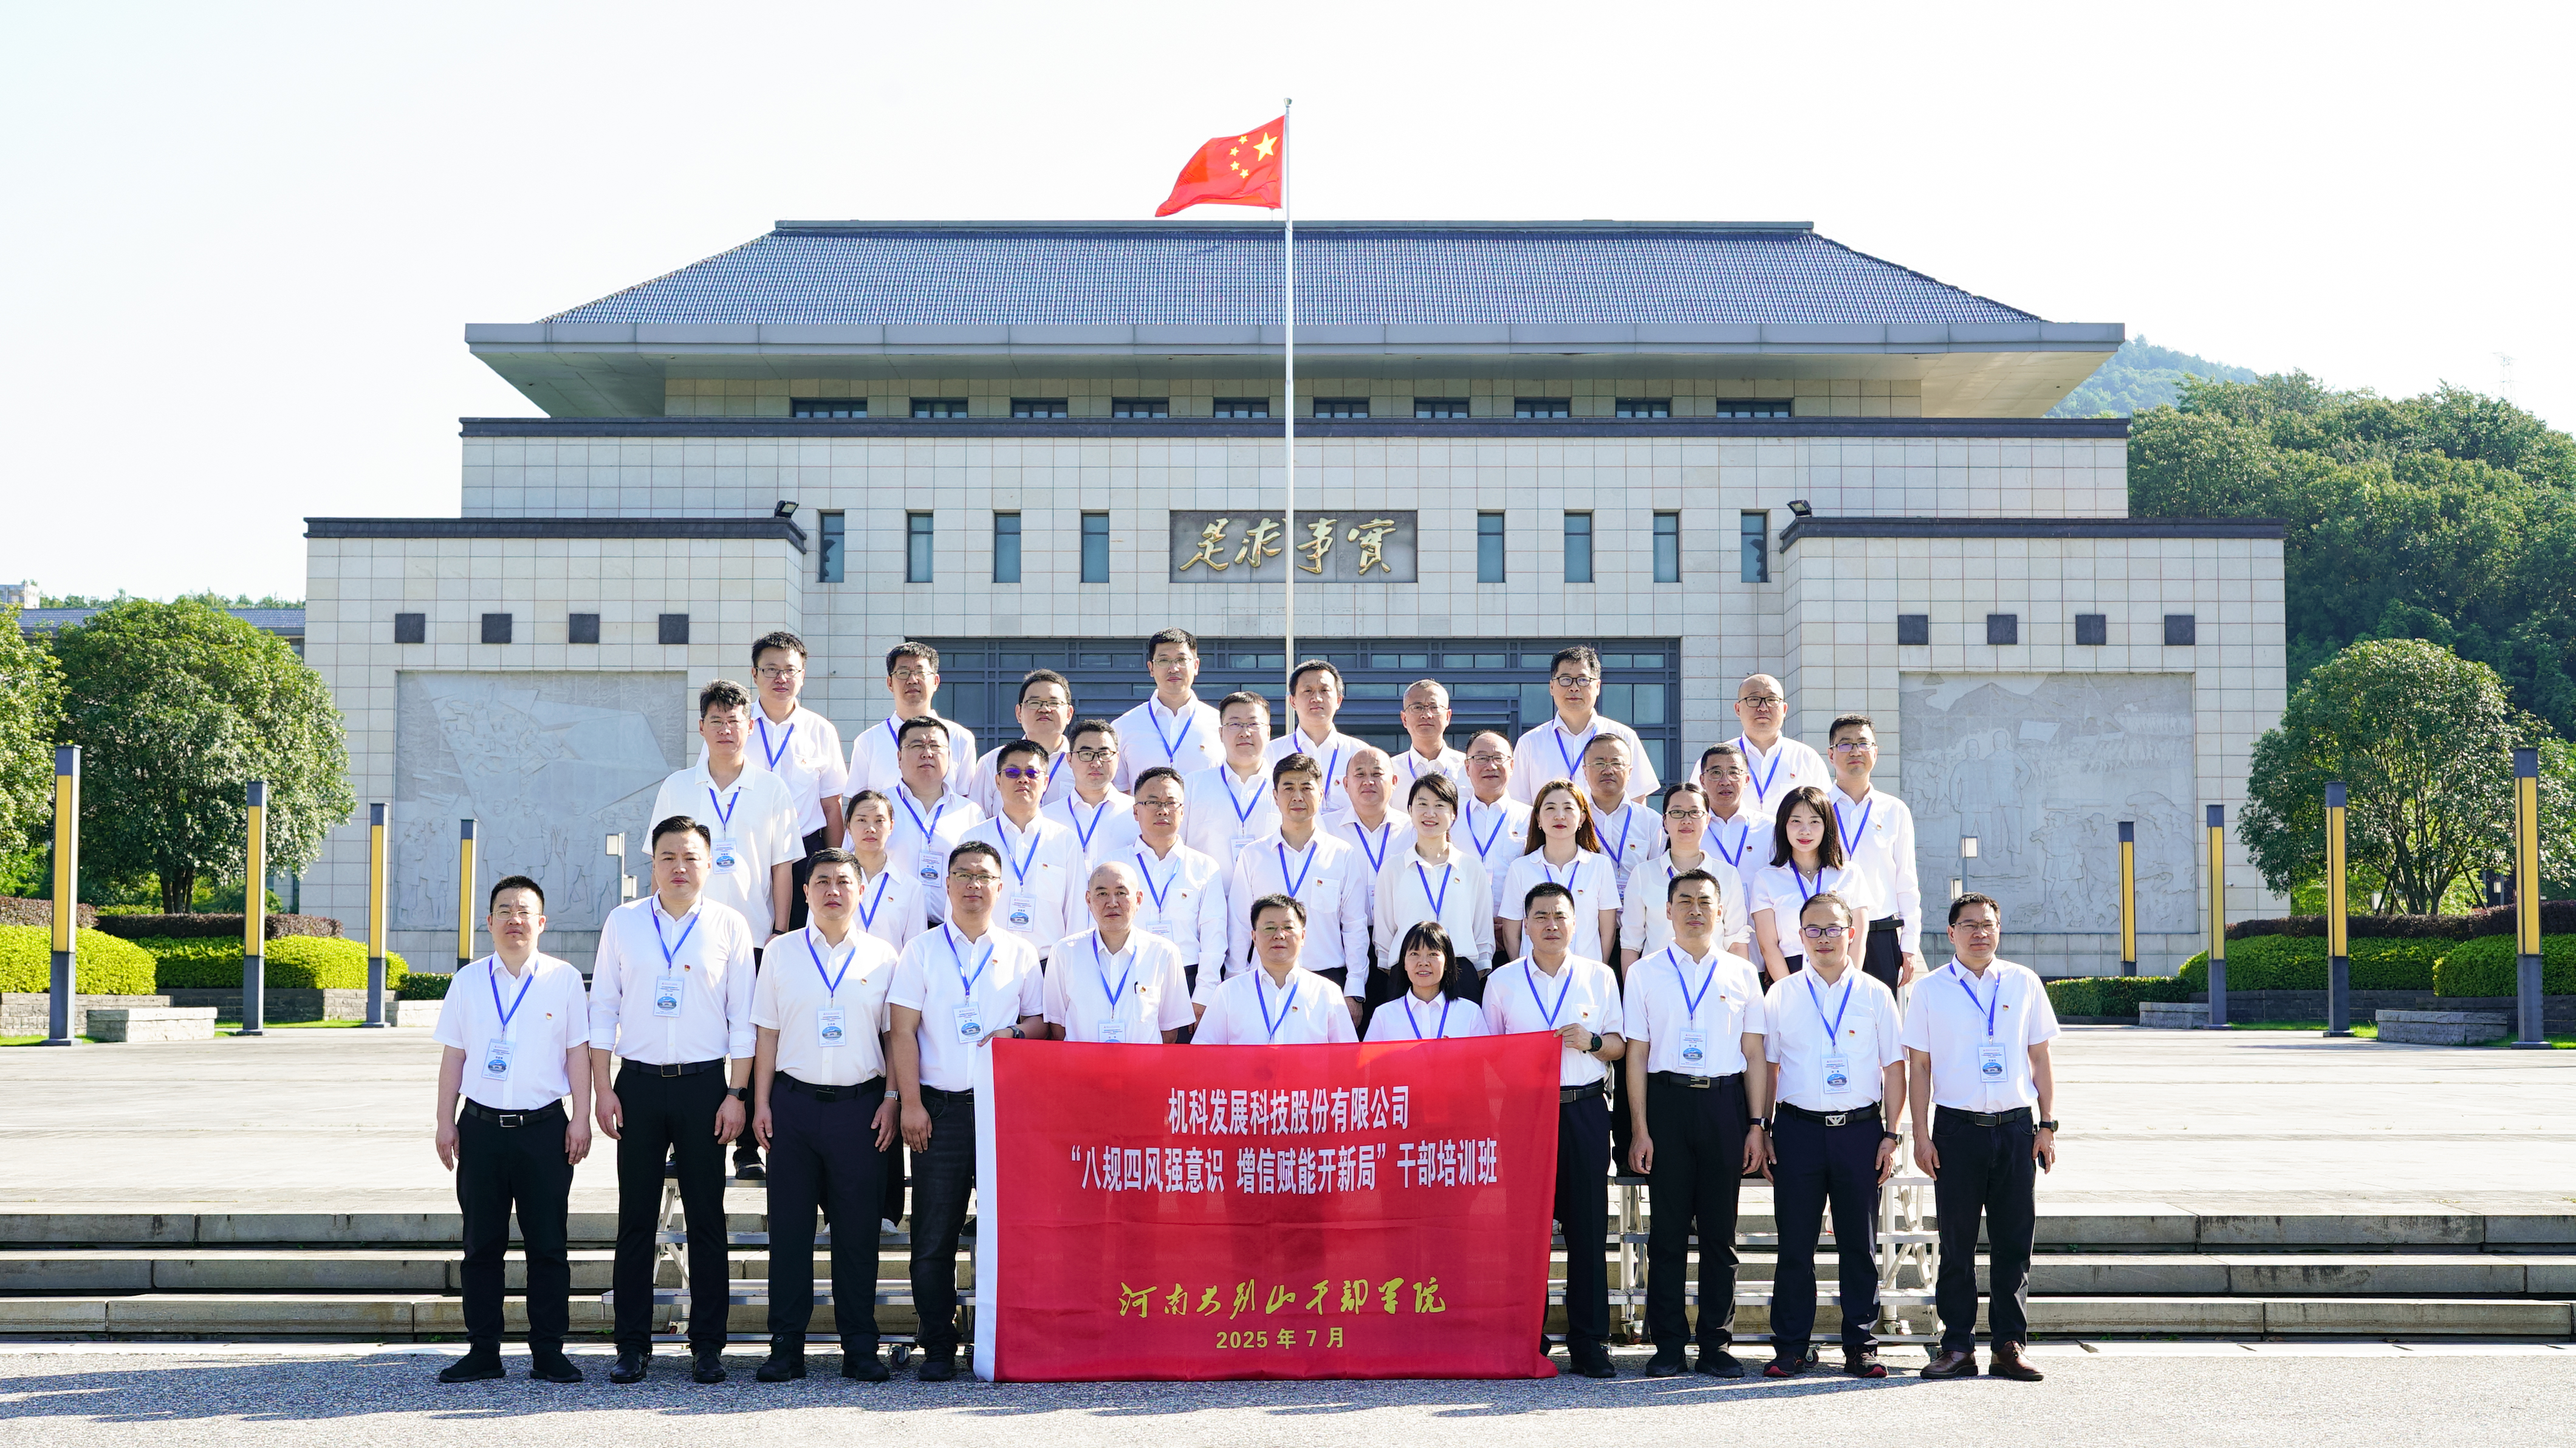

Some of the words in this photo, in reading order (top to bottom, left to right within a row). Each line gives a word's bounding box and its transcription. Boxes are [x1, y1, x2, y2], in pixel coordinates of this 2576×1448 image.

[1168, 1085, 1410, 1136] 机科发展科技股份有限公司
[1118, 1276, 1446, 1320] 河南大别山干部学院
